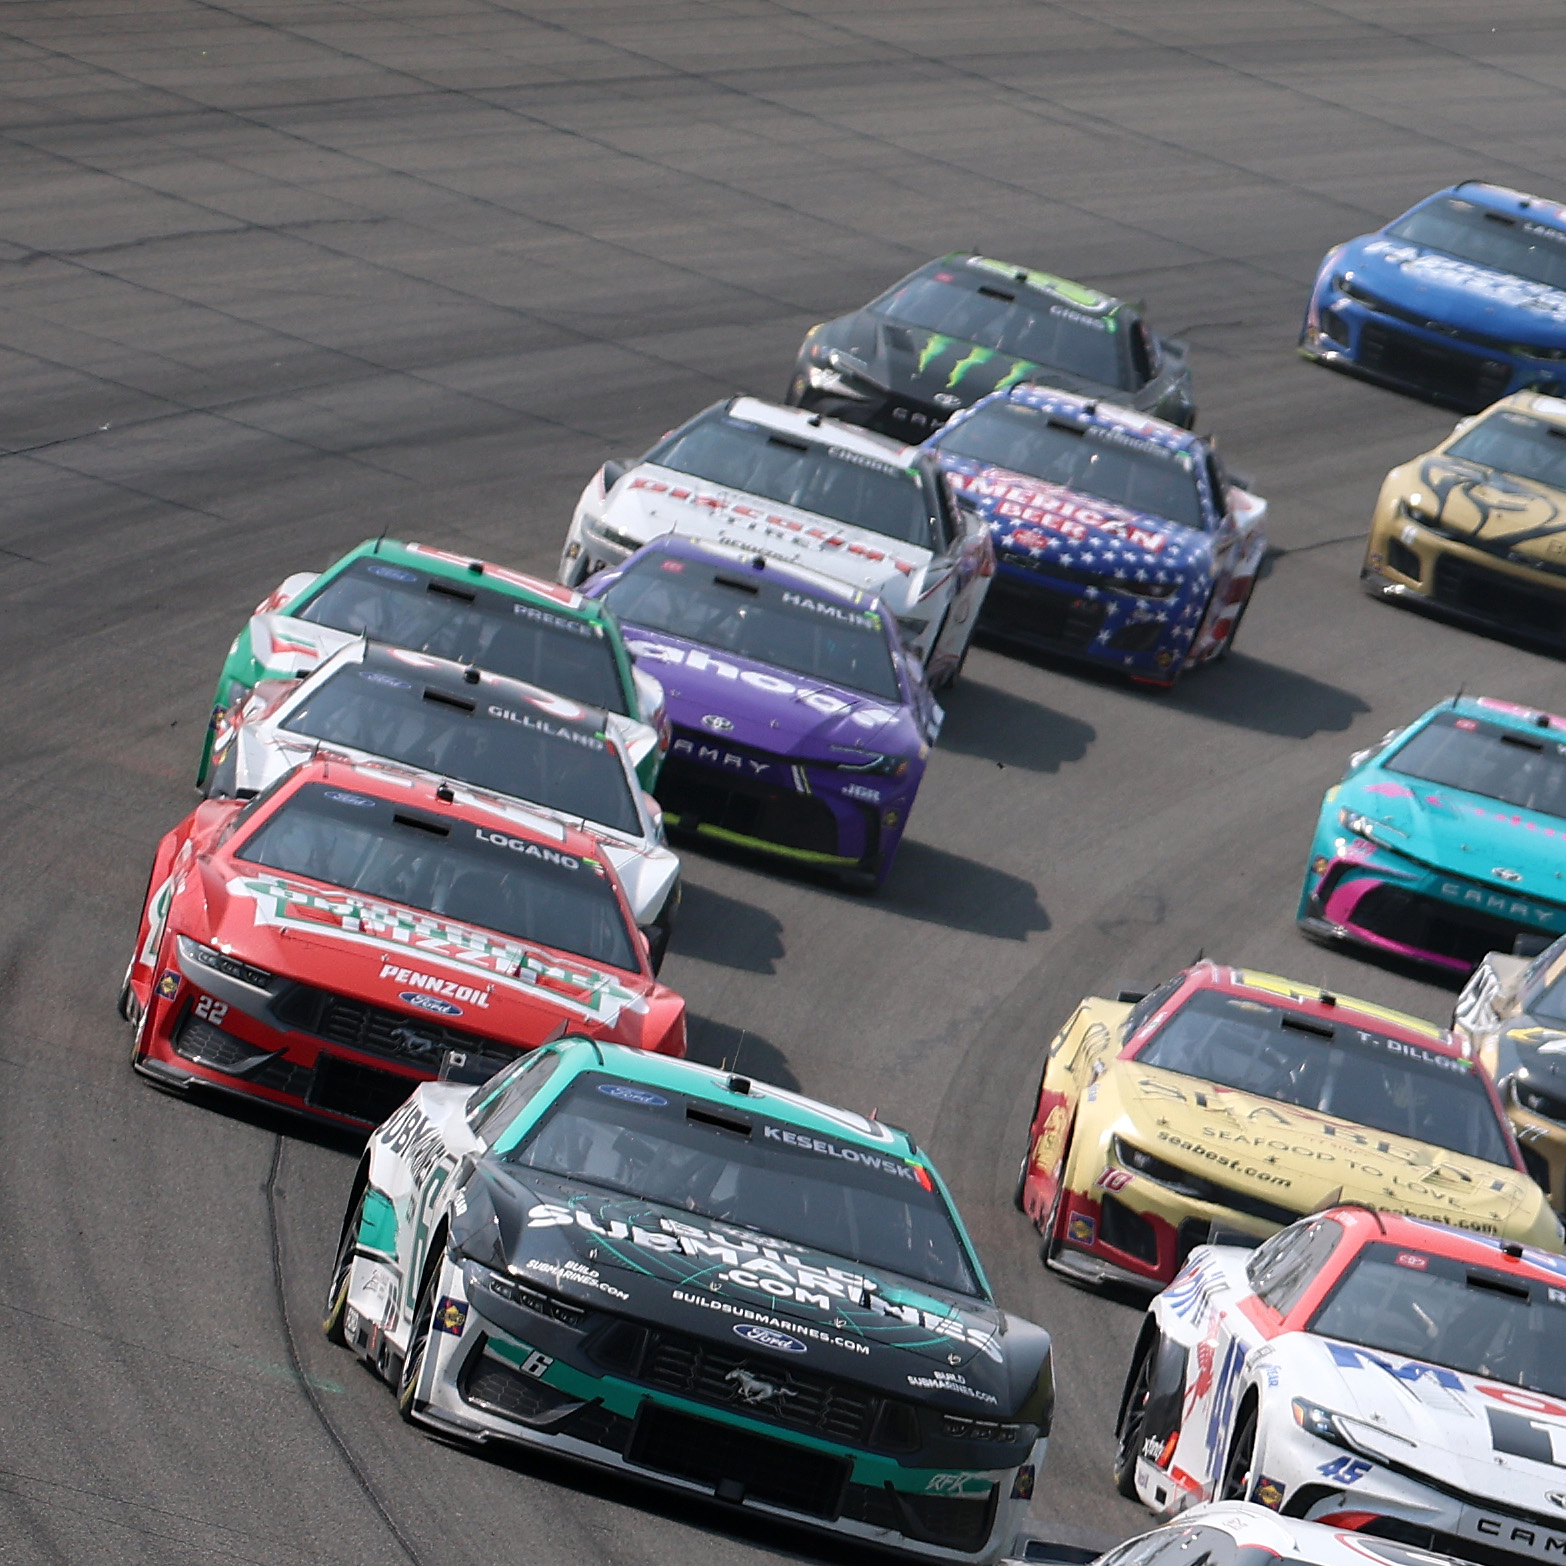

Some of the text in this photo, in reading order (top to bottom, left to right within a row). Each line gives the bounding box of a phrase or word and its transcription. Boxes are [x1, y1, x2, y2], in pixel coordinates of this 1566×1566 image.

[945, 472, 1167, 553] AMERICAN
[996, 501, 1089, 541] BEER
[512, 602, 593, 638] PREECE
[781, 591, 872, 629] HAMLIN
[626, 637, 904, 729] ahoo!
[487, 704, 604, 752] GILLILAND
[673, 736, 773, 776] AMRY
[474, 828, 581, 870] LOGANO
[379, 963, 492, 1010] PENNZOIL
[194, 995, 228, 1025] 22
[764, 1126, 917, 1182] KESELOWSKI
[1157, 1130, 1293, 1189] seabest.com
[1202, 1126, 1336, 1163] SEAFOOD
[1345, 1159, 1384, 1178] TO
[1095, 1167, 1136, 1193] 10
[525, 1257, 630, 1302] SUBMARINES.COM
[563, 1257, 601, 1280] BUILD
[718, 1265, 831, 1312] .COM
[672, 1289, 871, 1355] BUILDSUBMARINES.COM
[521, 1350, 556, 1379] 6
[1317, 1455, 1373, 1485] 45
